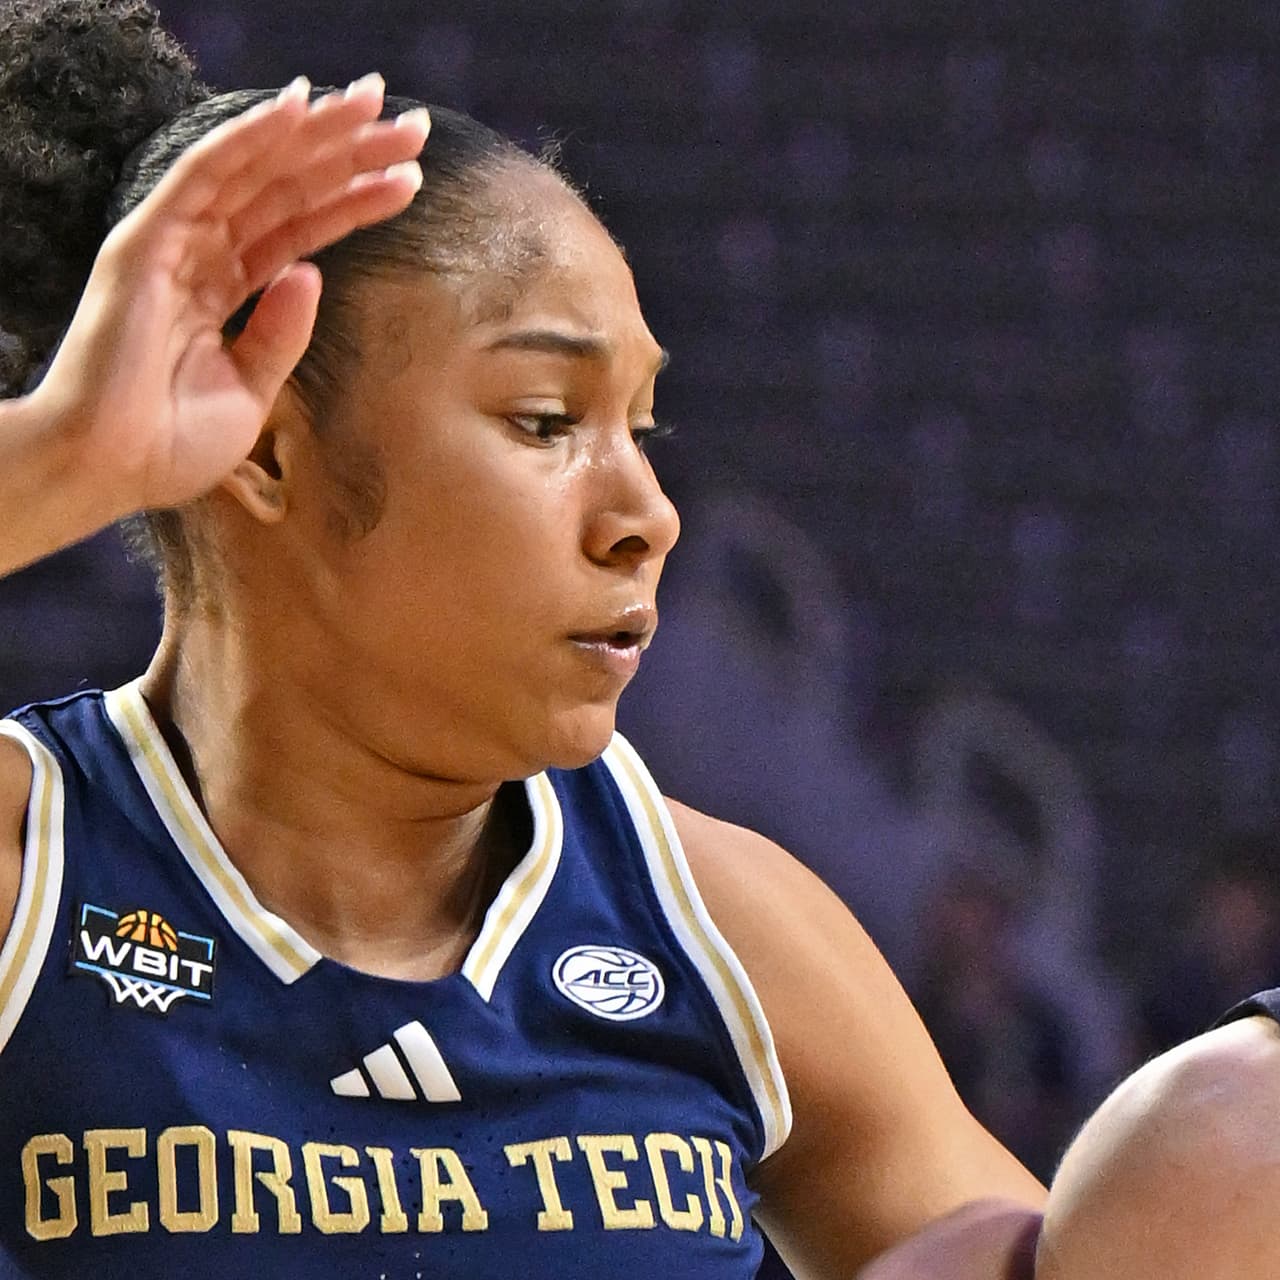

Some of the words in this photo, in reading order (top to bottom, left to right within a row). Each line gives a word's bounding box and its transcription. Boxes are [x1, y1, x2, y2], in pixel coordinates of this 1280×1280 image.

[80, 930, 213, 987] WBIT
[570, 968, 652, 986] ACC
[22, 1125, 488, 1242] GEORGIA
[505, 1133, 743, 1243] TECH
